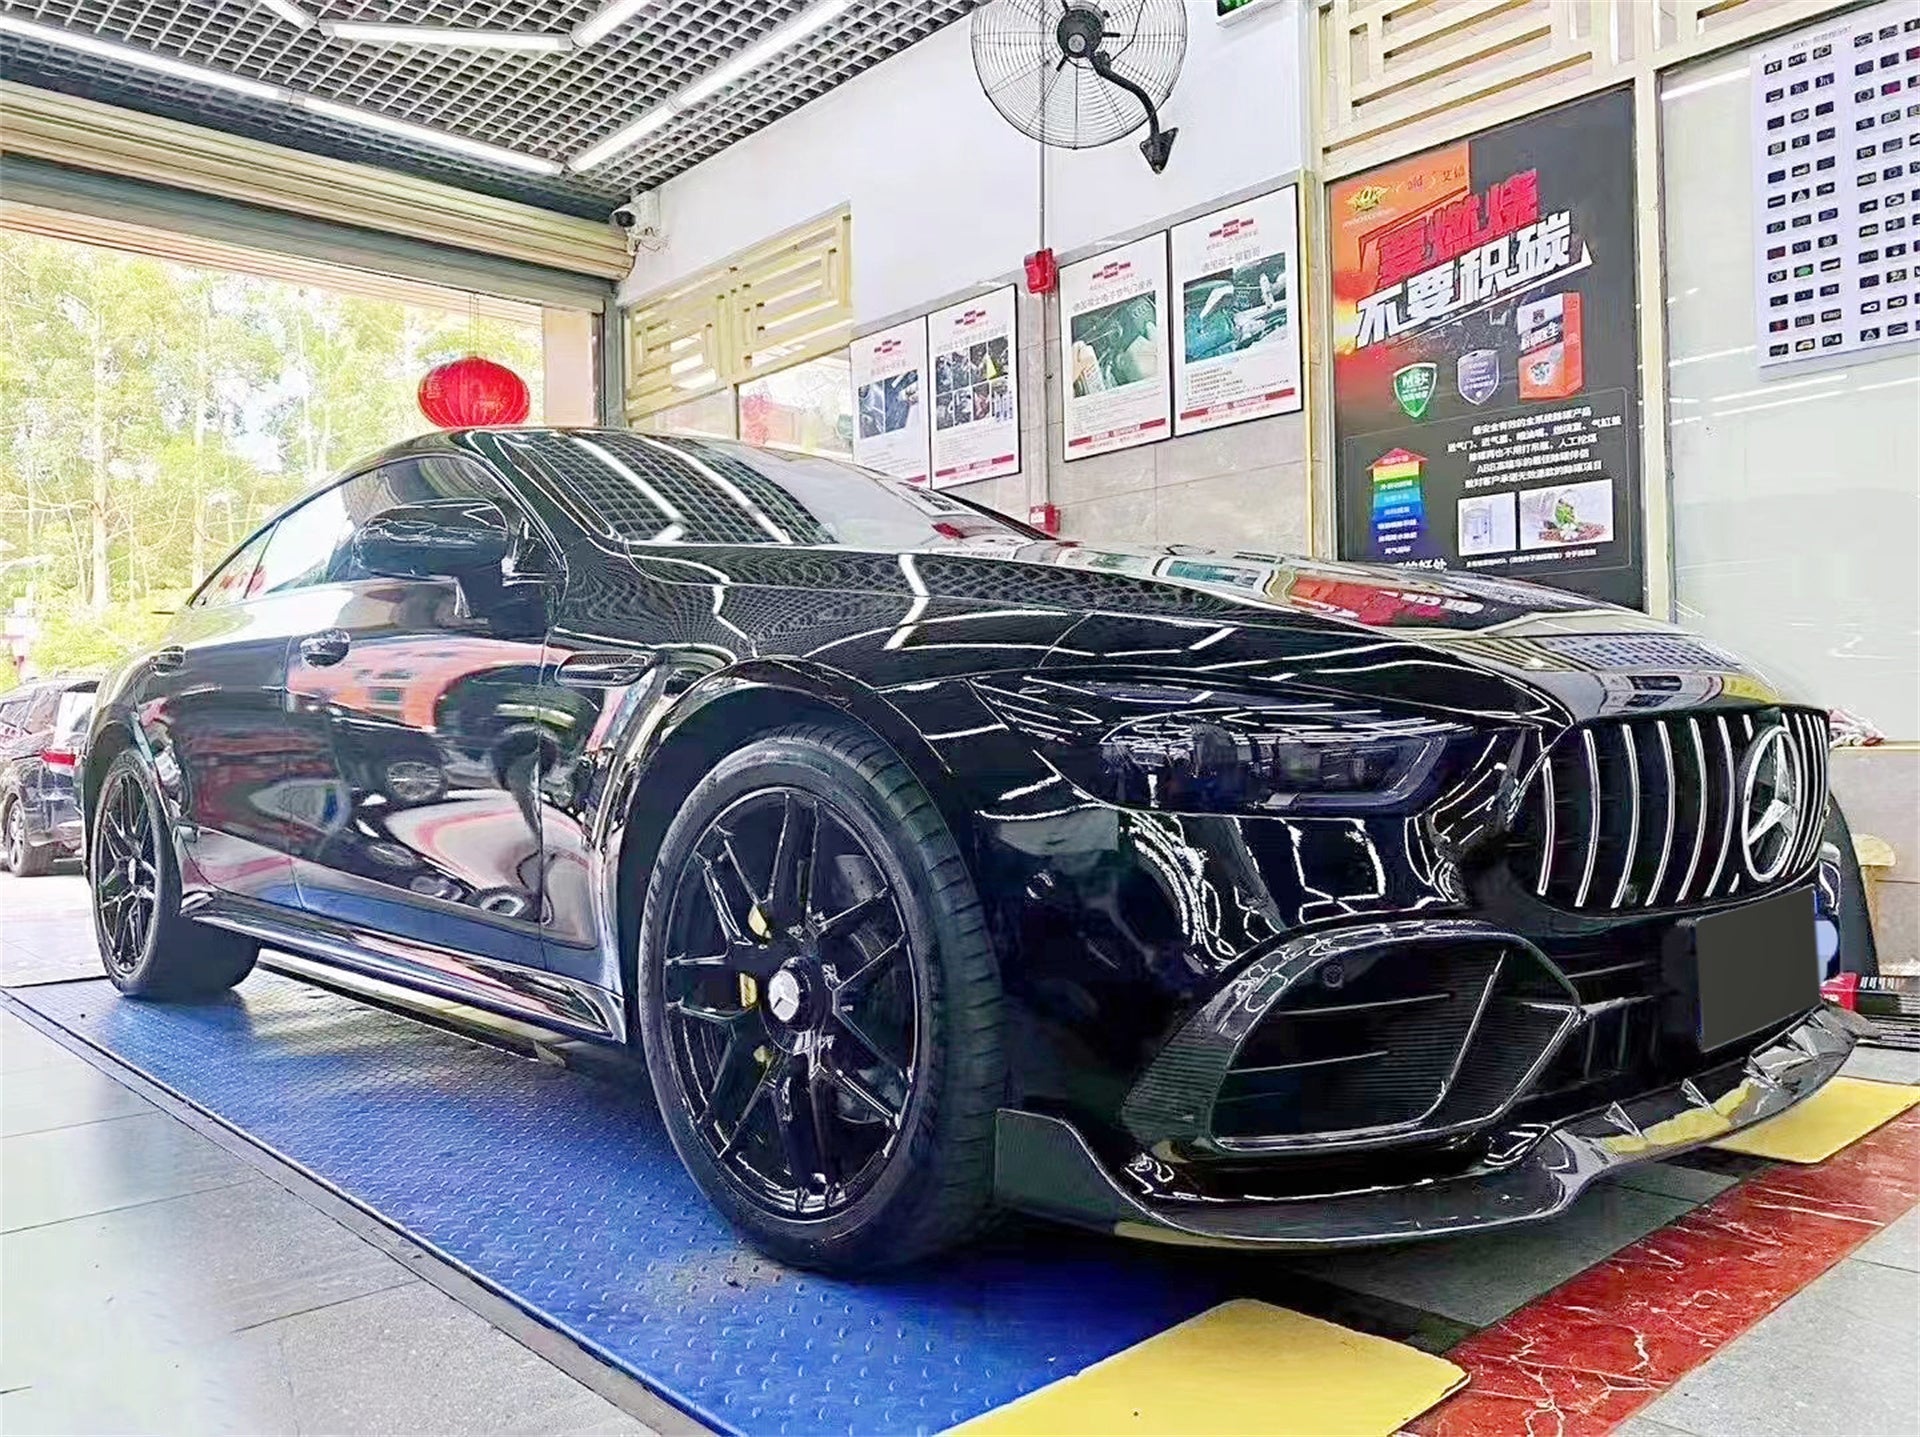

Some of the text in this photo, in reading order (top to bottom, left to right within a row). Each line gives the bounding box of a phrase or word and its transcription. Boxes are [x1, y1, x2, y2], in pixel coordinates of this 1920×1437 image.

[1356, 210, 1571, 350] 不要积碳
[1376, 168, 1537, 292] 要燃烧
